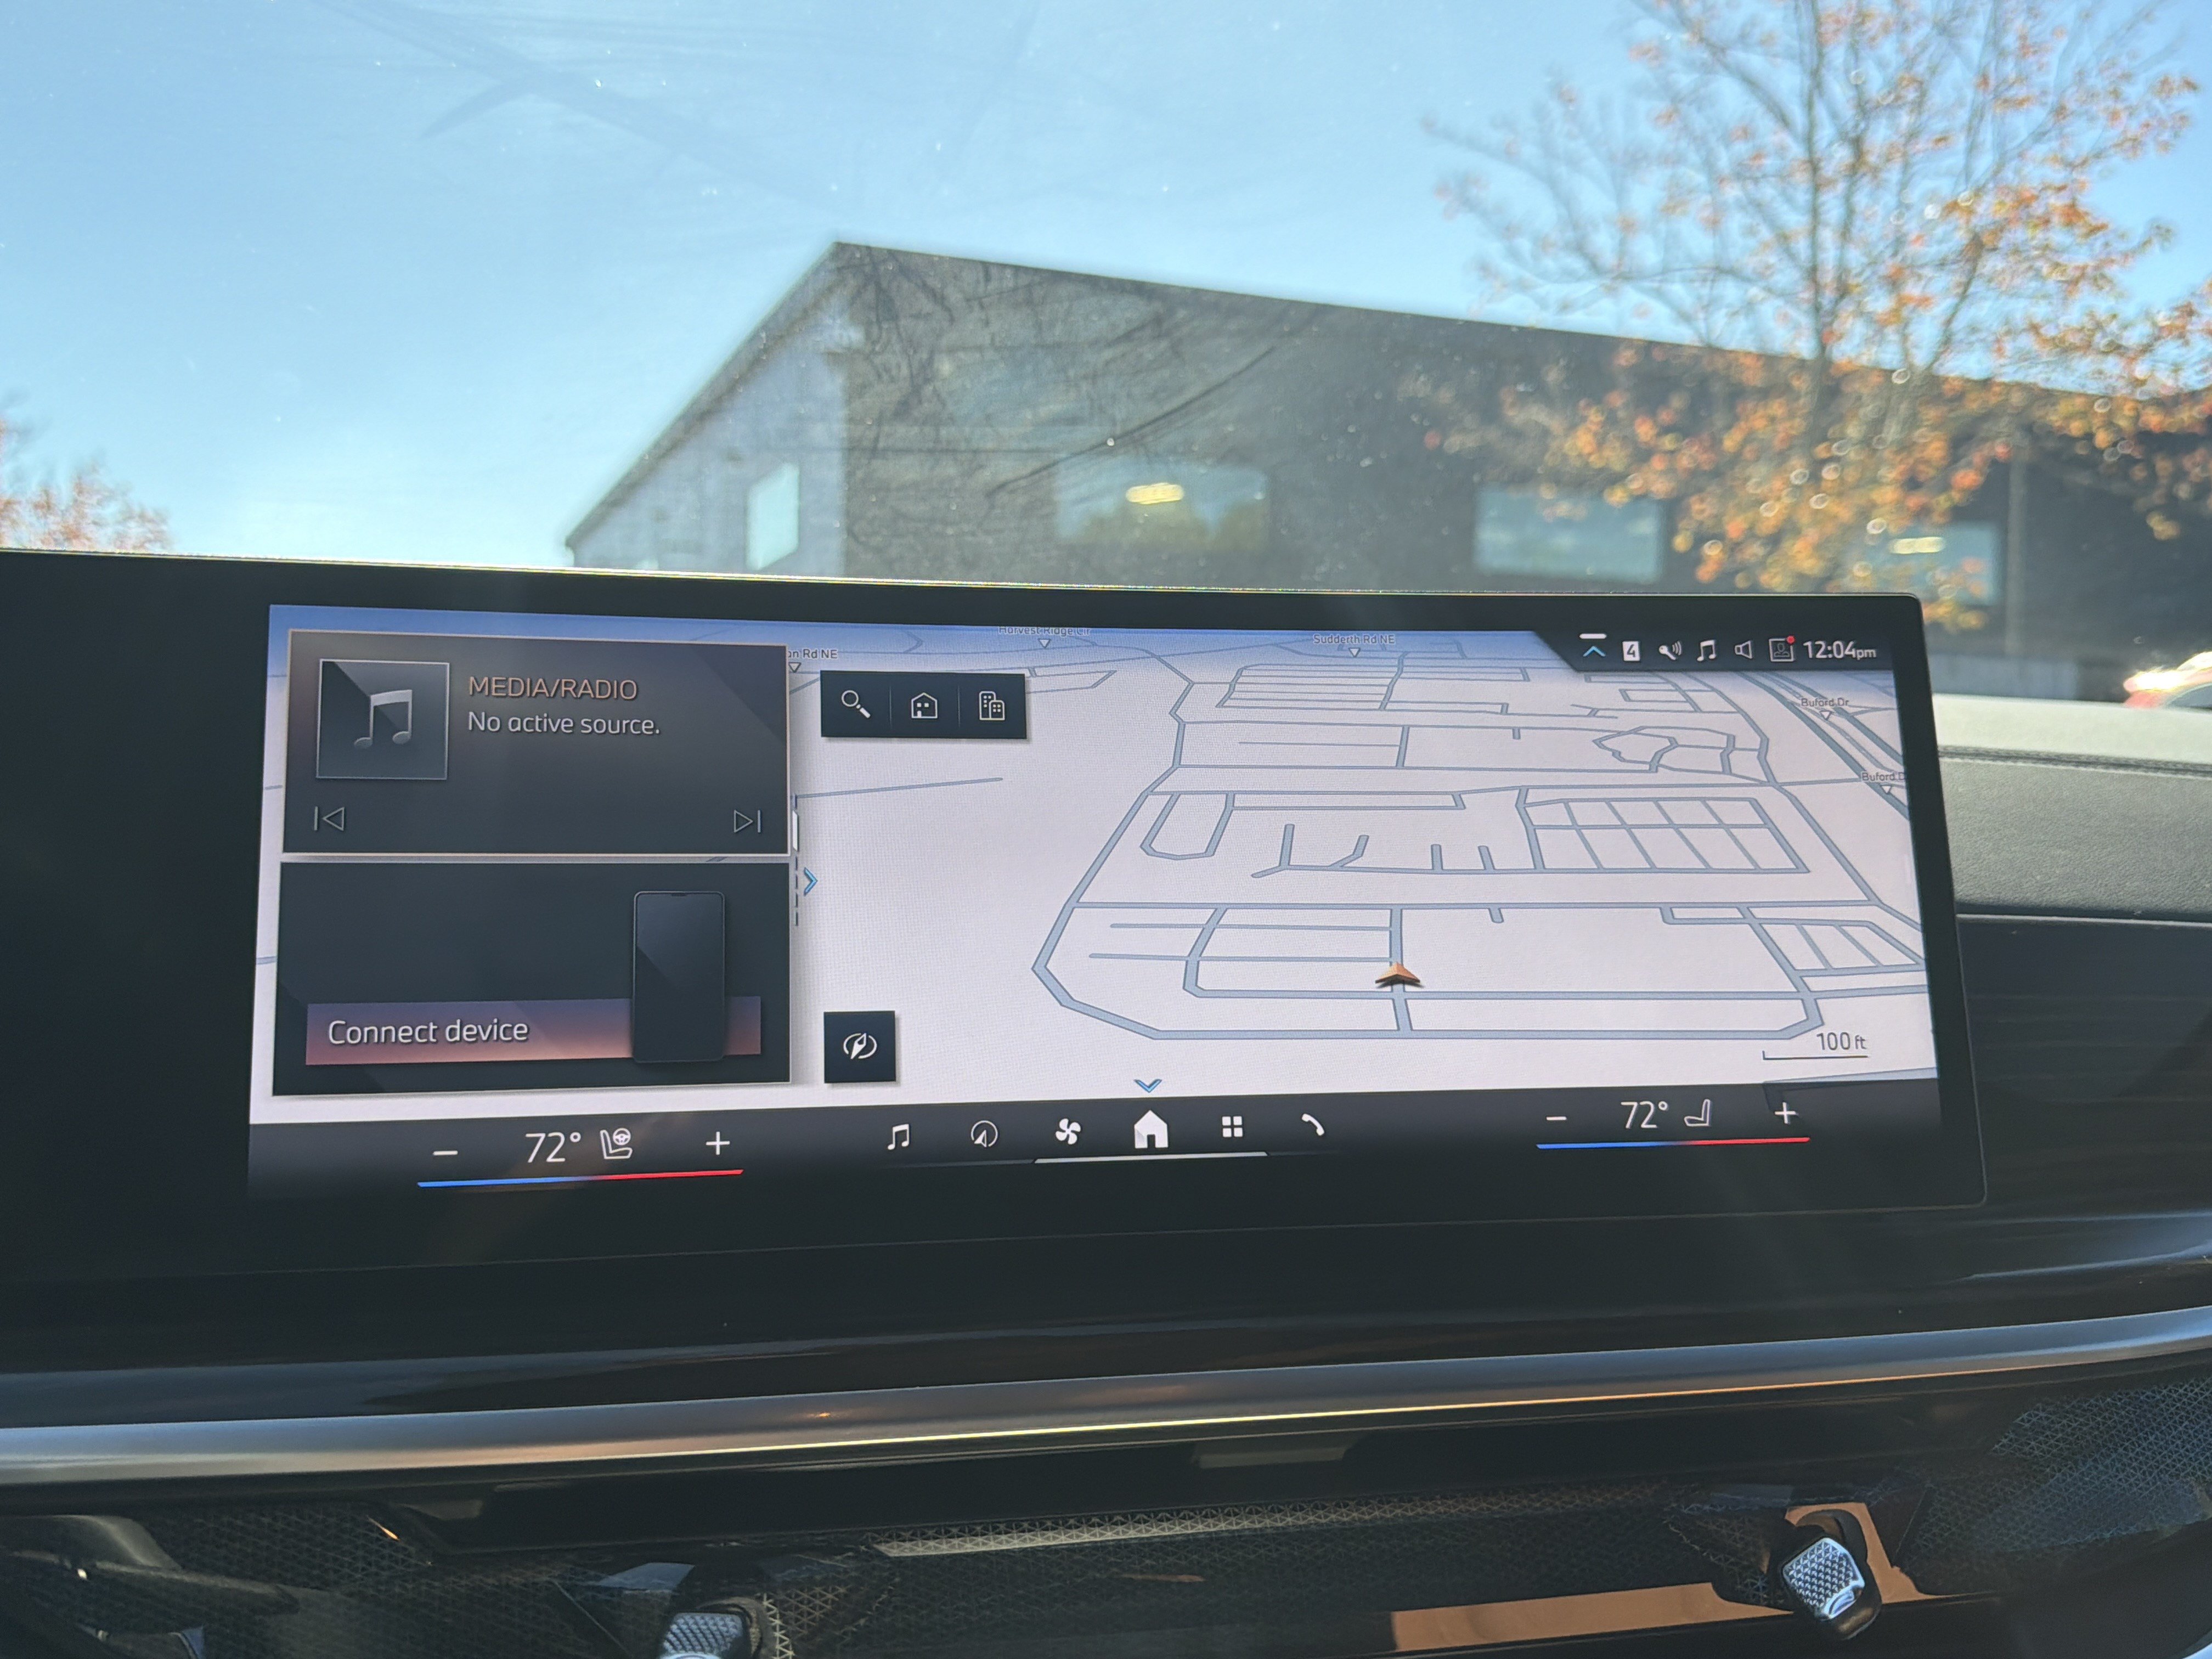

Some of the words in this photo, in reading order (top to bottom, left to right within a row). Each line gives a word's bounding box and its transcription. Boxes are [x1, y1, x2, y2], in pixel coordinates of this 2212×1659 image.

[998, 627, 1040, 635] Harvest
[1314, 634, 1361, 644] Sudderth
[1364, 634, 1377, 644] Rd
[1379, 634, 1395, 644] NE
[803, 648, 818, 658] Rd
[821, 649, 838, 659] NE
[1626, 643, 1636, 657] 4
[469, 675, 639, 700] MEDIA/RADIO
[1801, 697, 1835, 708] Buford
[1837, 697, 1849, 707] Dr
[468, 712, 501, 732] No
[508, 713, 573, 733] active
[580, 717, 661, 735] source.
[1862, 771, 1895, 781] Buford
[328, 1019, 437, 1045] Connect
[444, 1018, 529, 1043] device
[1816, 1032, 1851, 1051] 100
[1854, 1035, 1866, 1049] ft
[1621, 1101, 1668, 1129] 72°
[525, 1131, 582, 1164] 72°
